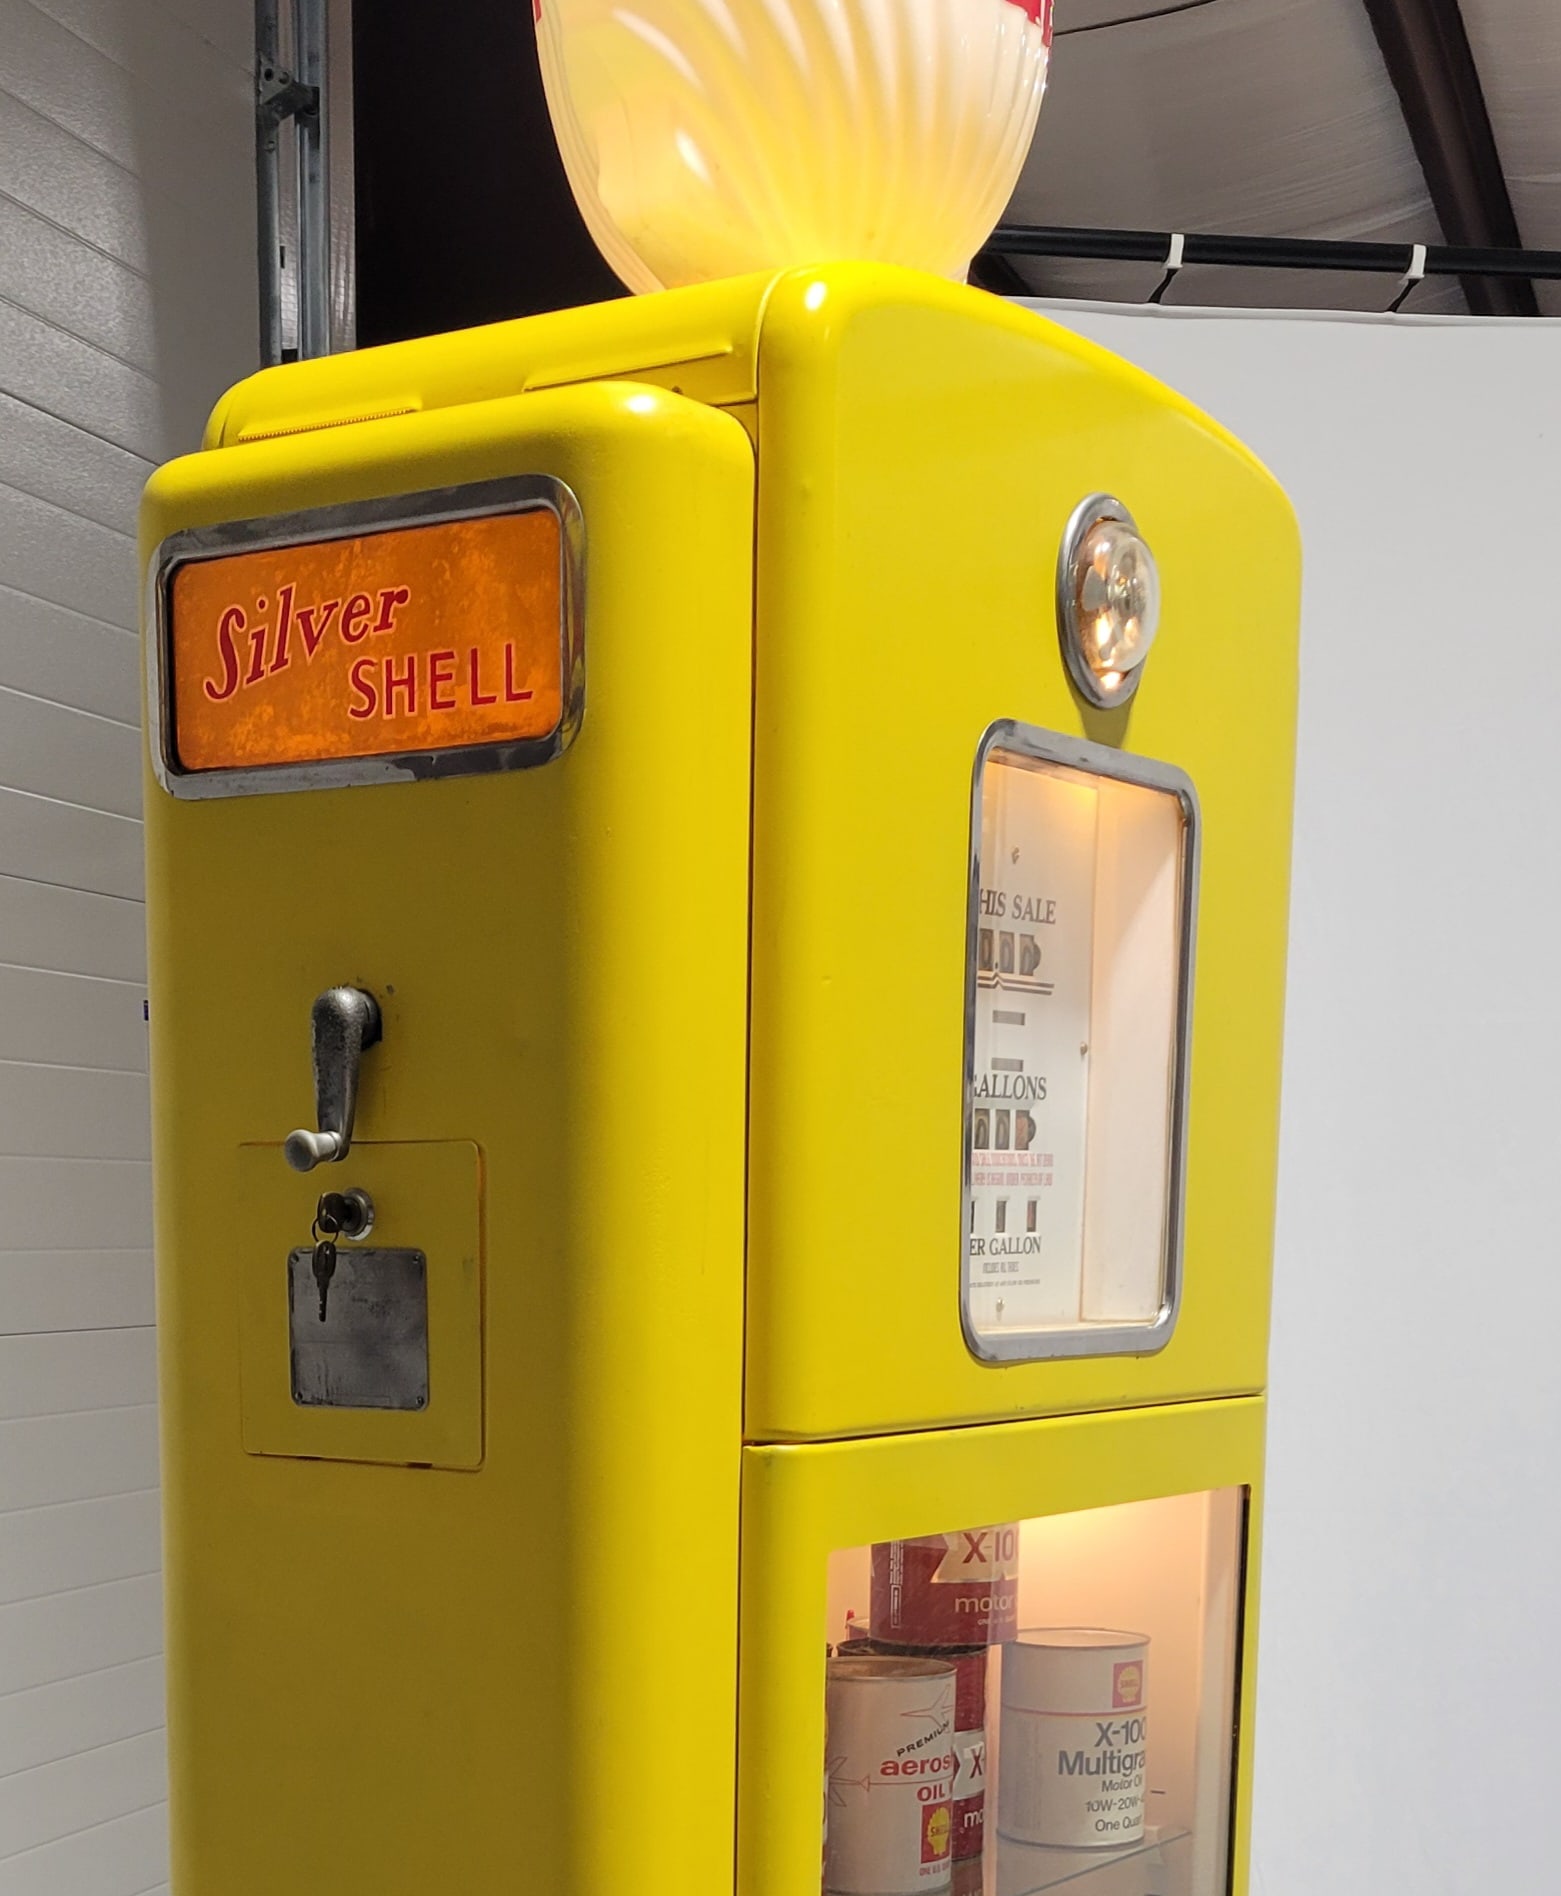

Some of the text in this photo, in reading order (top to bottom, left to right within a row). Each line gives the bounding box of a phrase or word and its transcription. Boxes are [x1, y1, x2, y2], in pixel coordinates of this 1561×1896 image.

[204, 581, 410, 702] Silver
[348, 642, 534, 720] SHELL
[1012, 894, 1056, 925] SALE
[989, 1236, 1041, 1256] GALLON
[962, 1529, 1019, 1564] X-10
[955, 1593, 1014, 1613] motor
[917, 1783, 945, 1802] OIL
[1101, 1779, 1132, 1793] Motor
[1095, 1819, 1120, 1832] One
